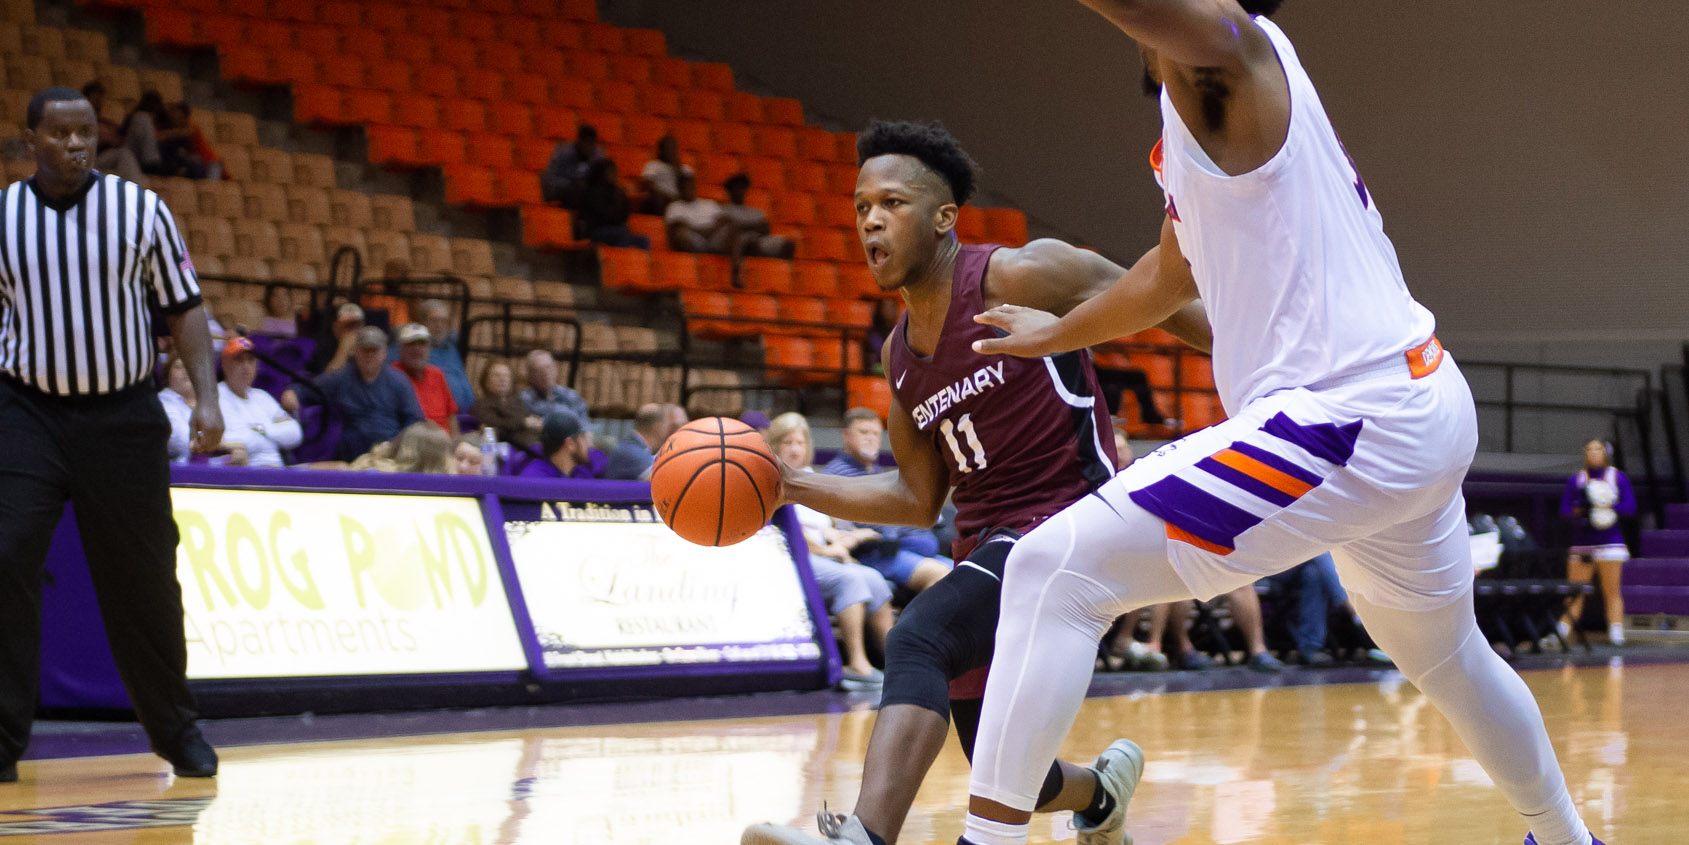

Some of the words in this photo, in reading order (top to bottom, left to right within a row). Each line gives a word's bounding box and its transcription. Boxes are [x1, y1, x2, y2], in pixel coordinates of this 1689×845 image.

[911, 360, 1005, 431] ENTENARY
[939, 412, 987, 474] 11
[541, 501, 558, 521] A
[556, 501, 633, 521] Tradition
[633, 504, 654, 521] in
[174, 508, 327, 612] ROG
[577, 556, 739, 616] Landing
[186, 608, 418, 668] Apartments
